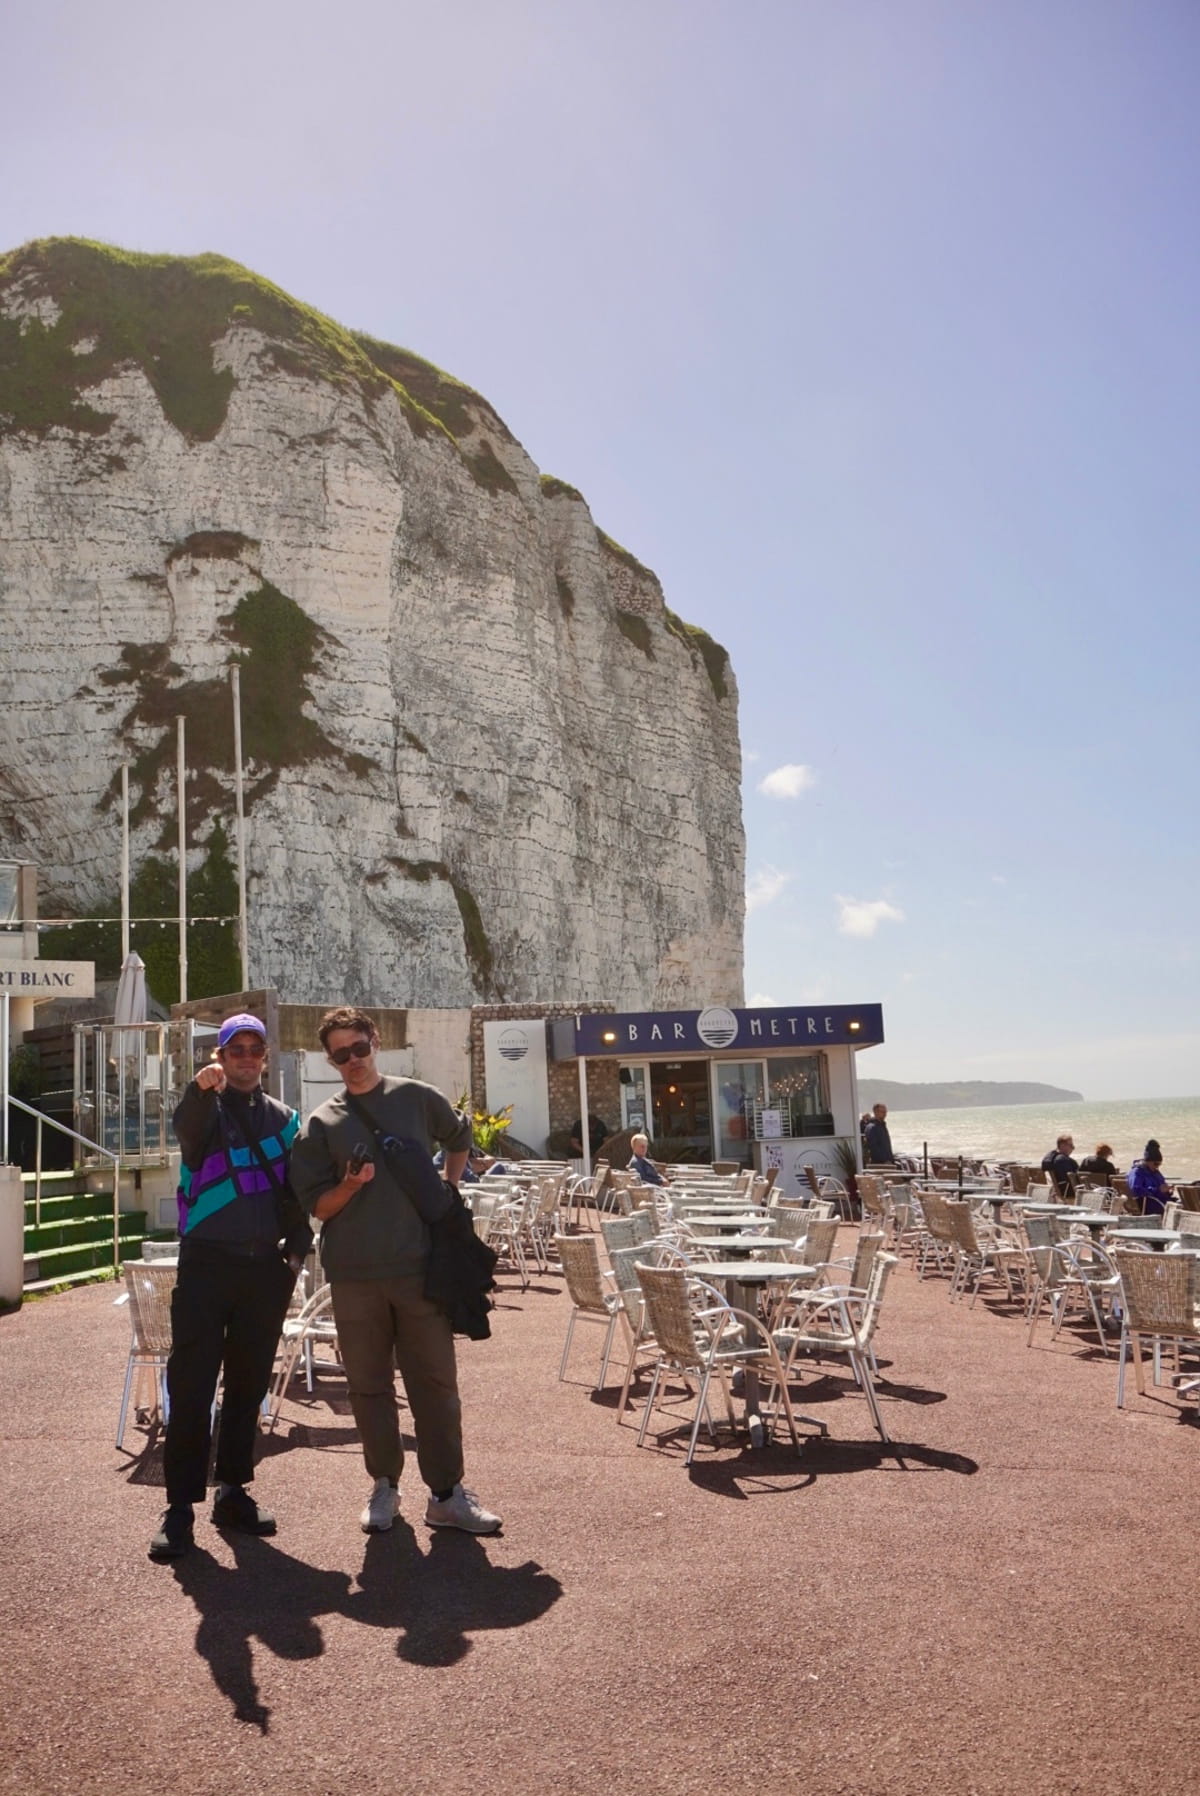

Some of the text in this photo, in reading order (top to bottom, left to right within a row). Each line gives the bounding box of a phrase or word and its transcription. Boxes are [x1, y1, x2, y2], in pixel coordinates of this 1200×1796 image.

[20, 971, 75, 987] BLANC
[628, 1022, 686, 1041] BAR
[750, 1017, 834, 1036] METRE
